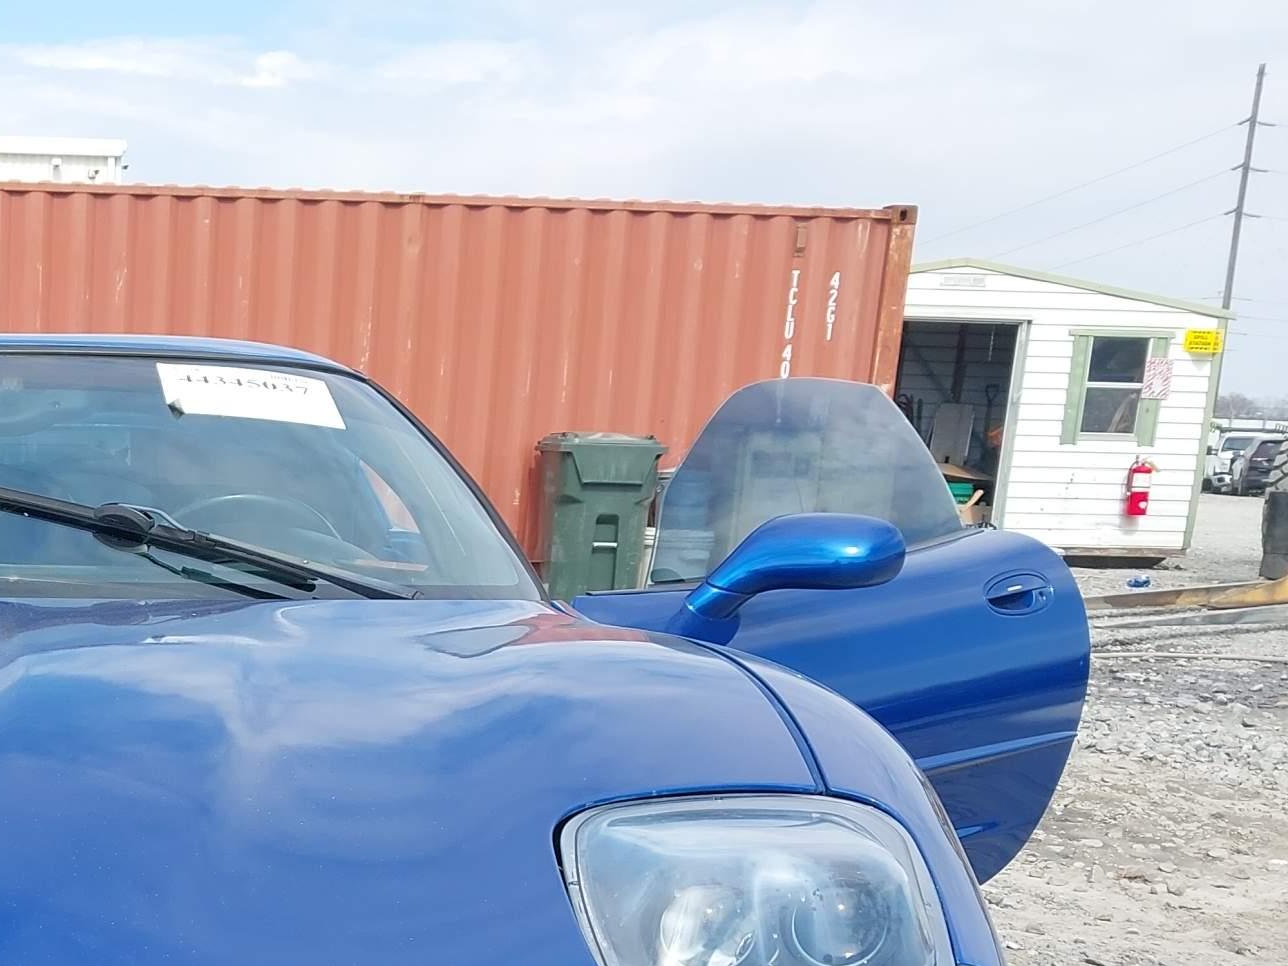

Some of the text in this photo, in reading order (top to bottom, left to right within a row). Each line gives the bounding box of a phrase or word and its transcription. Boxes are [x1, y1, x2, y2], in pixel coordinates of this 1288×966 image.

[784, 270, 800, 339] TCLU
[826, 272, 840, 341] 42G1
[176, 375, 308, 395] 44345037
